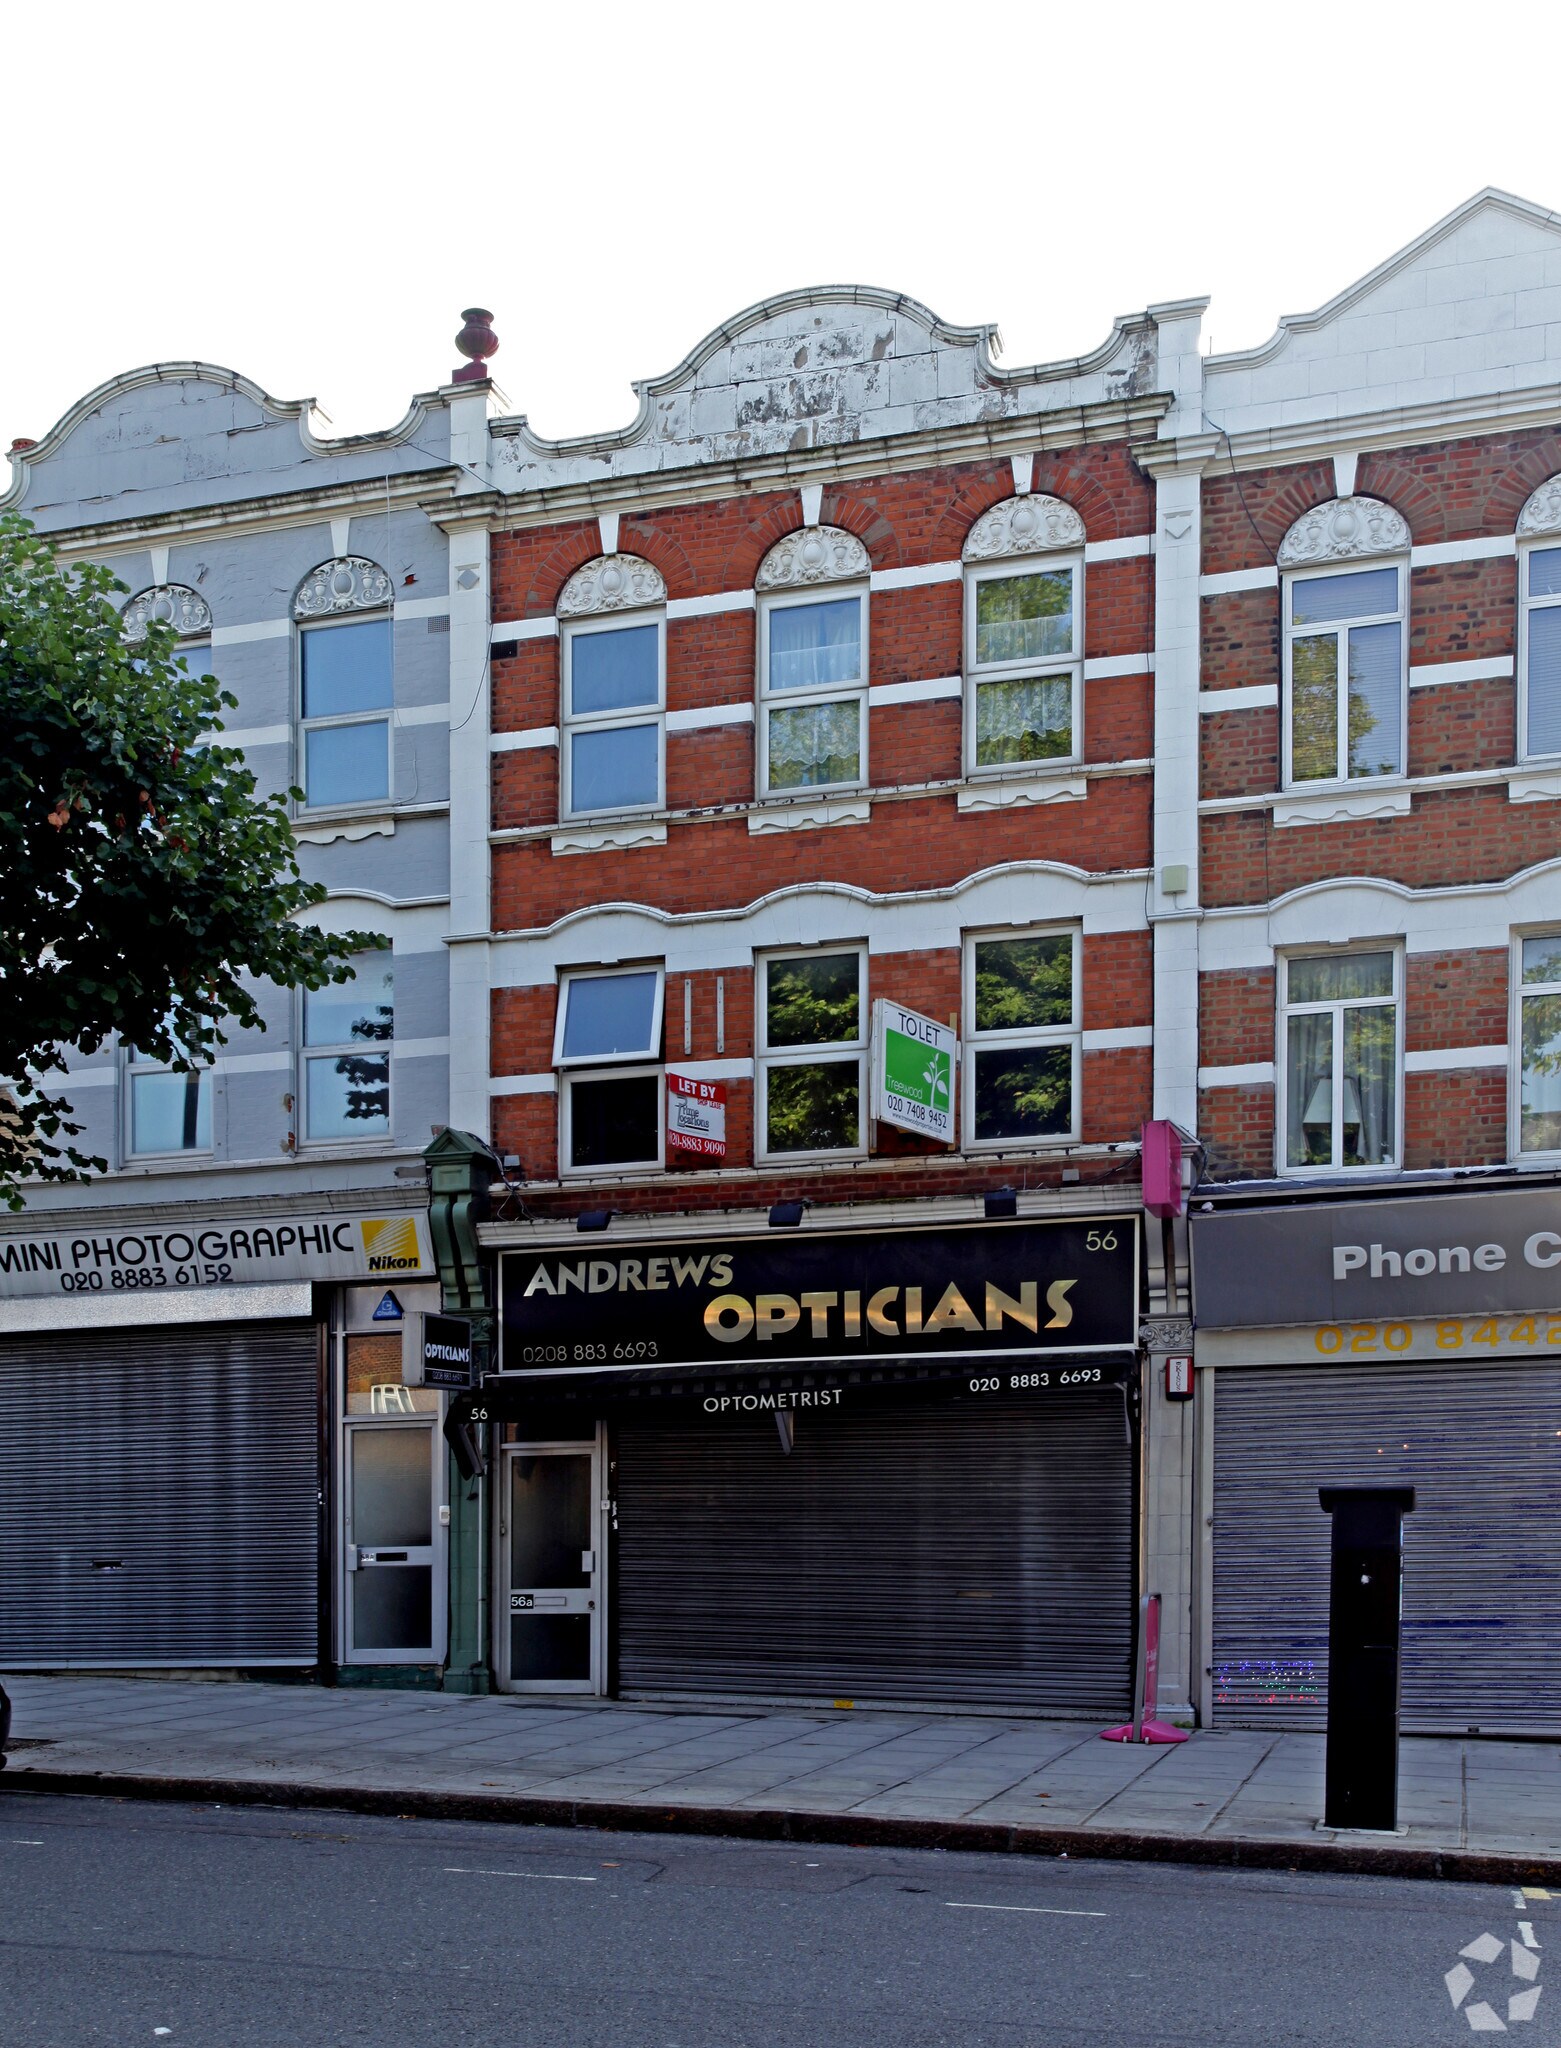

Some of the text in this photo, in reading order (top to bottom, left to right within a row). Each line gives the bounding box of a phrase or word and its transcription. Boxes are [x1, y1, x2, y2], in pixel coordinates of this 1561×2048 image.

[678, 1078, 717, 1099] LET BY
[886, 1074, 923, 1100] Treewood
[675, 1094, 700, 1118] Prime
[887, 1095, 903, 1112] 020
[907, 1101, 926, 1120] 7408
[928, 1109, 947, 1128] 9452
[677, 1112, 710, 1128] Locations
[704, 1140, 726, 1156] 9090
[71, 1223, 355, 1269] PHOTOGRAPHIC
[1086, 1229, 1119, 1252] 56
[368, 1255, 419, 1272] Nikon
[1333, 1243, 1507, 1281] Phone
[60, 1263, 234, 1292] 020 8883 6152
[523, 1253, 734, 1297] ANDREWS
[703, 1278, 1079, 1344] OPTICIANS
[1314, 1323, 1413, 1355] 020
[425, 1342, 470, 1363] OPTICIANS
[523, 1341, 659, 1363] 0208 883 6693
[969, 1368, 1101, 1392] 020 8883 6693
[703, 1389, 843, 1413] OPTOMETRIST
[470, 1408, 489, 1420] 56
[511, 1596, 533, 1607] 56a
